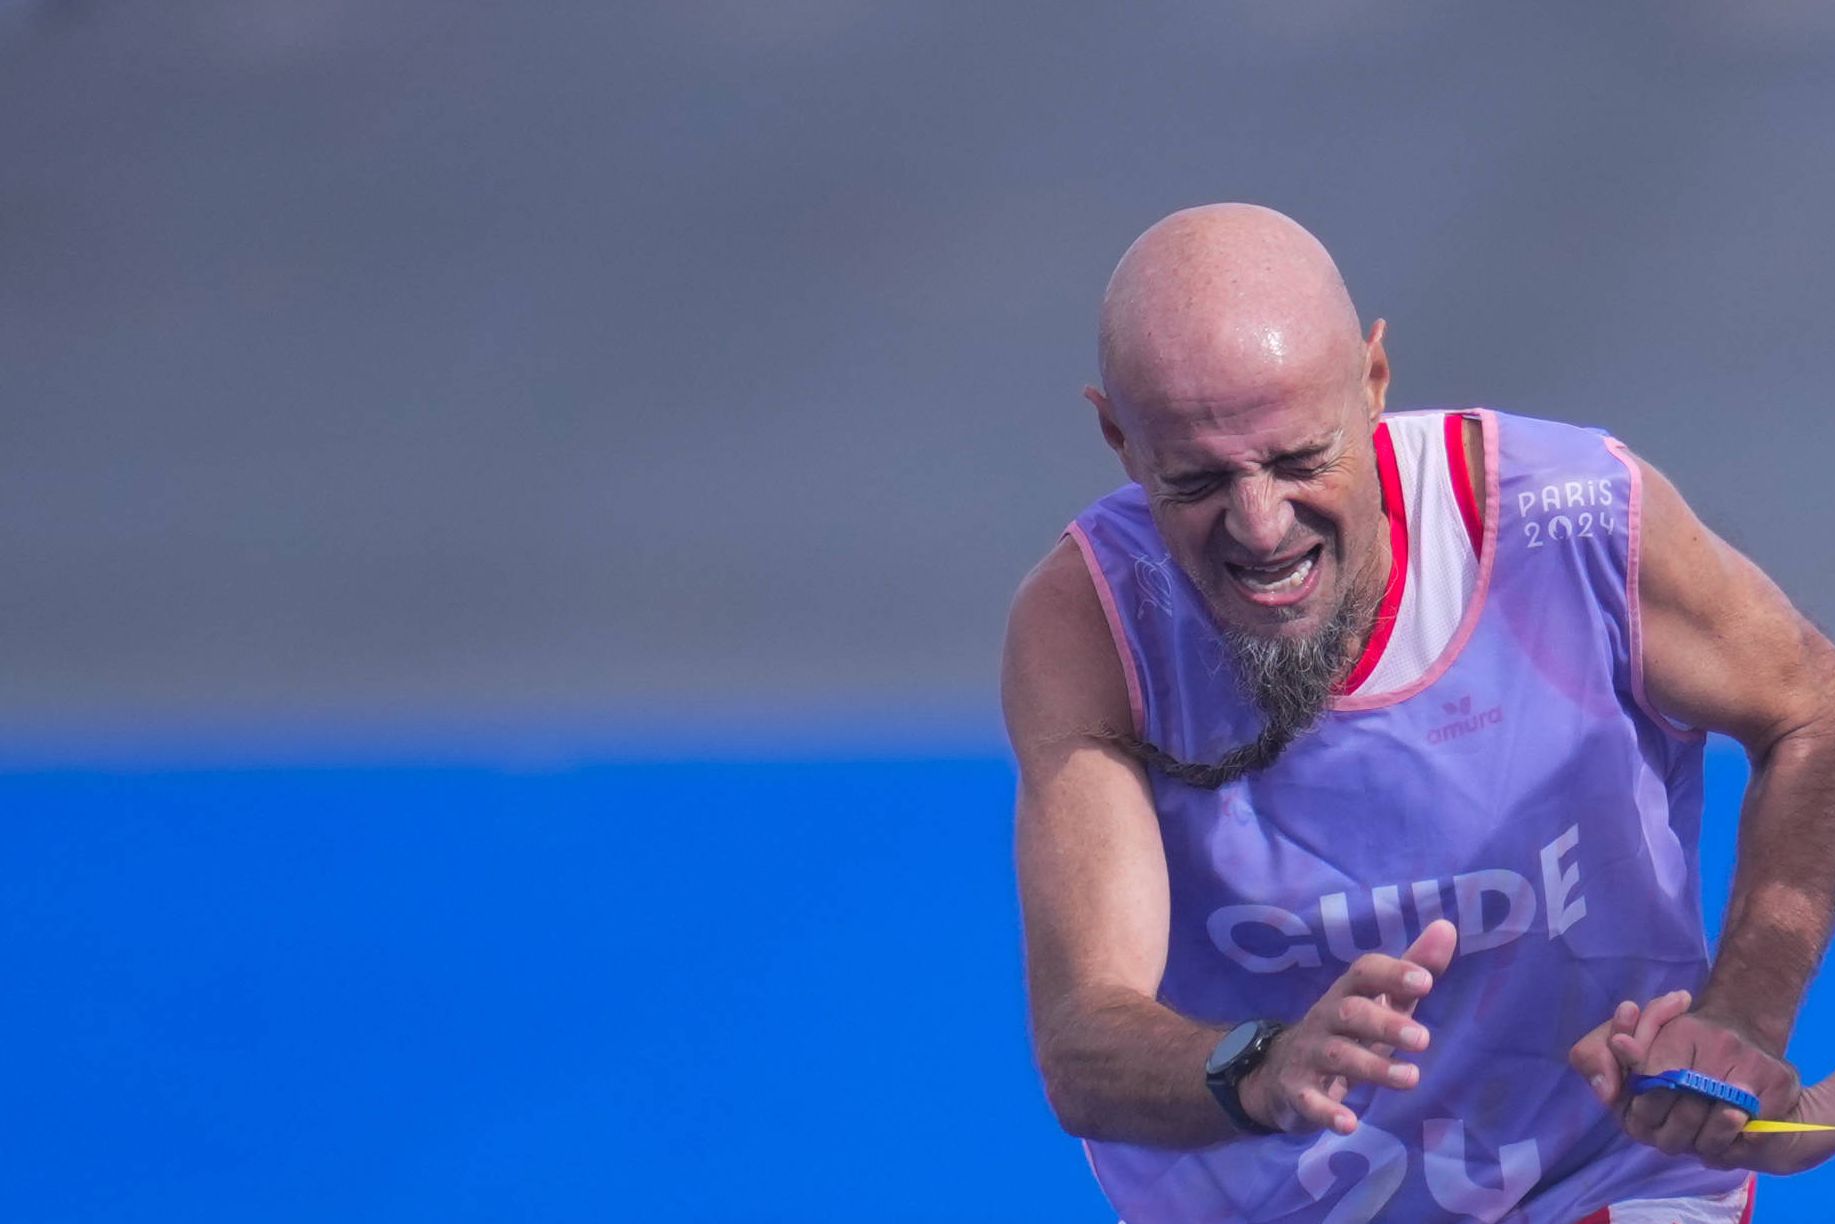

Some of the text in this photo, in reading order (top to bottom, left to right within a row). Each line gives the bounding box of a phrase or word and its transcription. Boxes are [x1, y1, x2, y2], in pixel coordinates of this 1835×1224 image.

[1517, 479, 1613, 518] PARIS
[1523, 511, 1615, 549] 2024
[1426, 706, 1505, 746] amura
[1206, 823, 1588, 974] GUIDE
